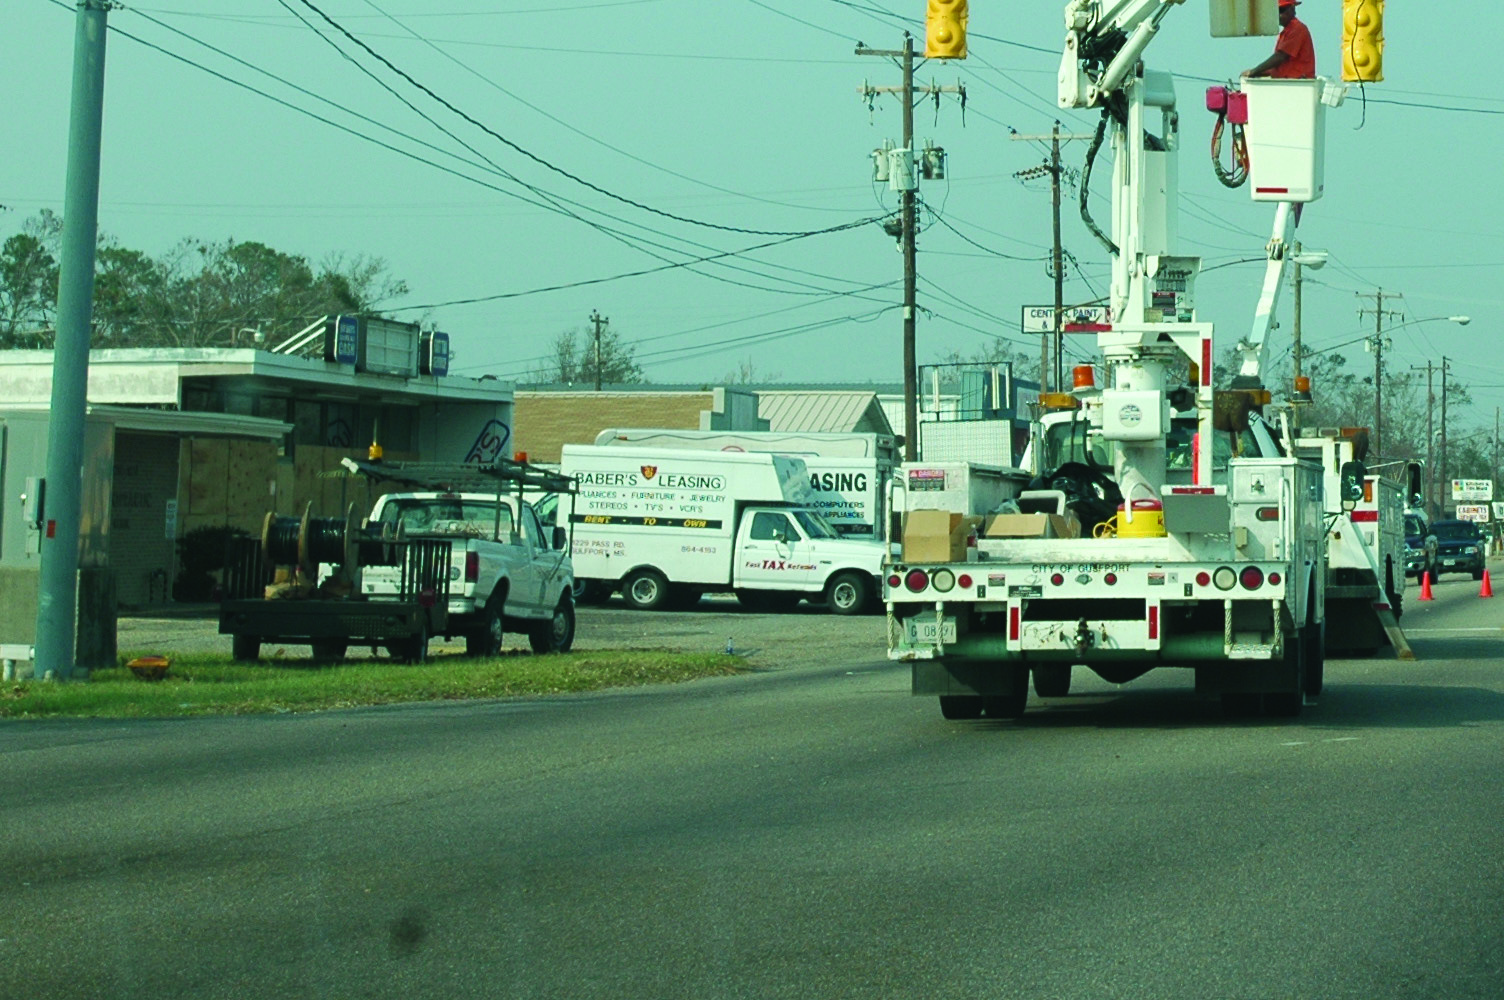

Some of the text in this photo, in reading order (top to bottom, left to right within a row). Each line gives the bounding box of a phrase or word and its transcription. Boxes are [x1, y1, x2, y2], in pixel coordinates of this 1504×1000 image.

[658, 474, 721, 489] LEASING
[809, 473, 867, 492] ASING
[589, 501, 629, 511] STEREOS
[584, 515, 708, 527] RENT TO OWN
[762, 560, 786, 571] TAX
[1031, 564, 1054, 573] CITY
[1060, 564, 1071, 573] OF
